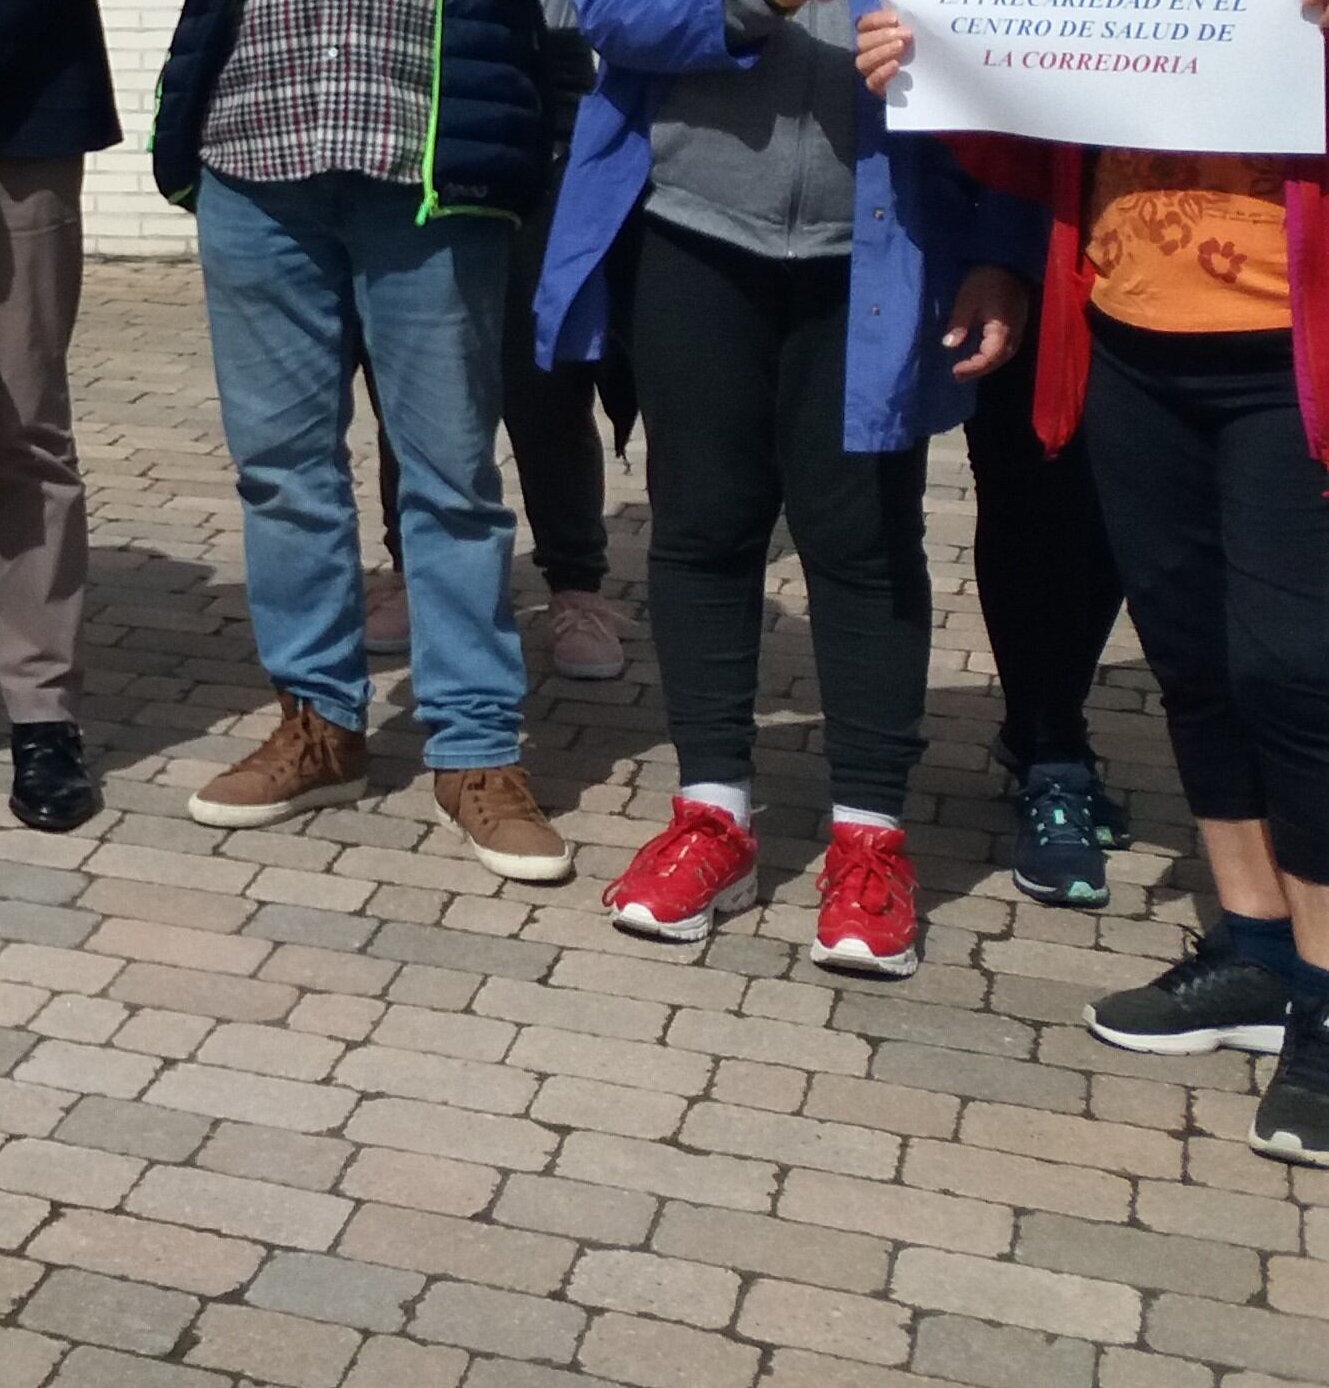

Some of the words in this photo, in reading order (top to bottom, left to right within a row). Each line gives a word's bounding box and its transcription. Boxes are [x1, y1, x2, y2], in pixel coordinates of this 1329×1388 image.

[950, 17, 1052, 37] CENTRO
[1059, 19, 1095, 38] DE
[1101, 21, 1189, 41] SALUD
[1197, 23, 1235, 42] DE
[983, 49, 1013, 68] LA
[1022, 51, 1198, 74] CORREDORIA
